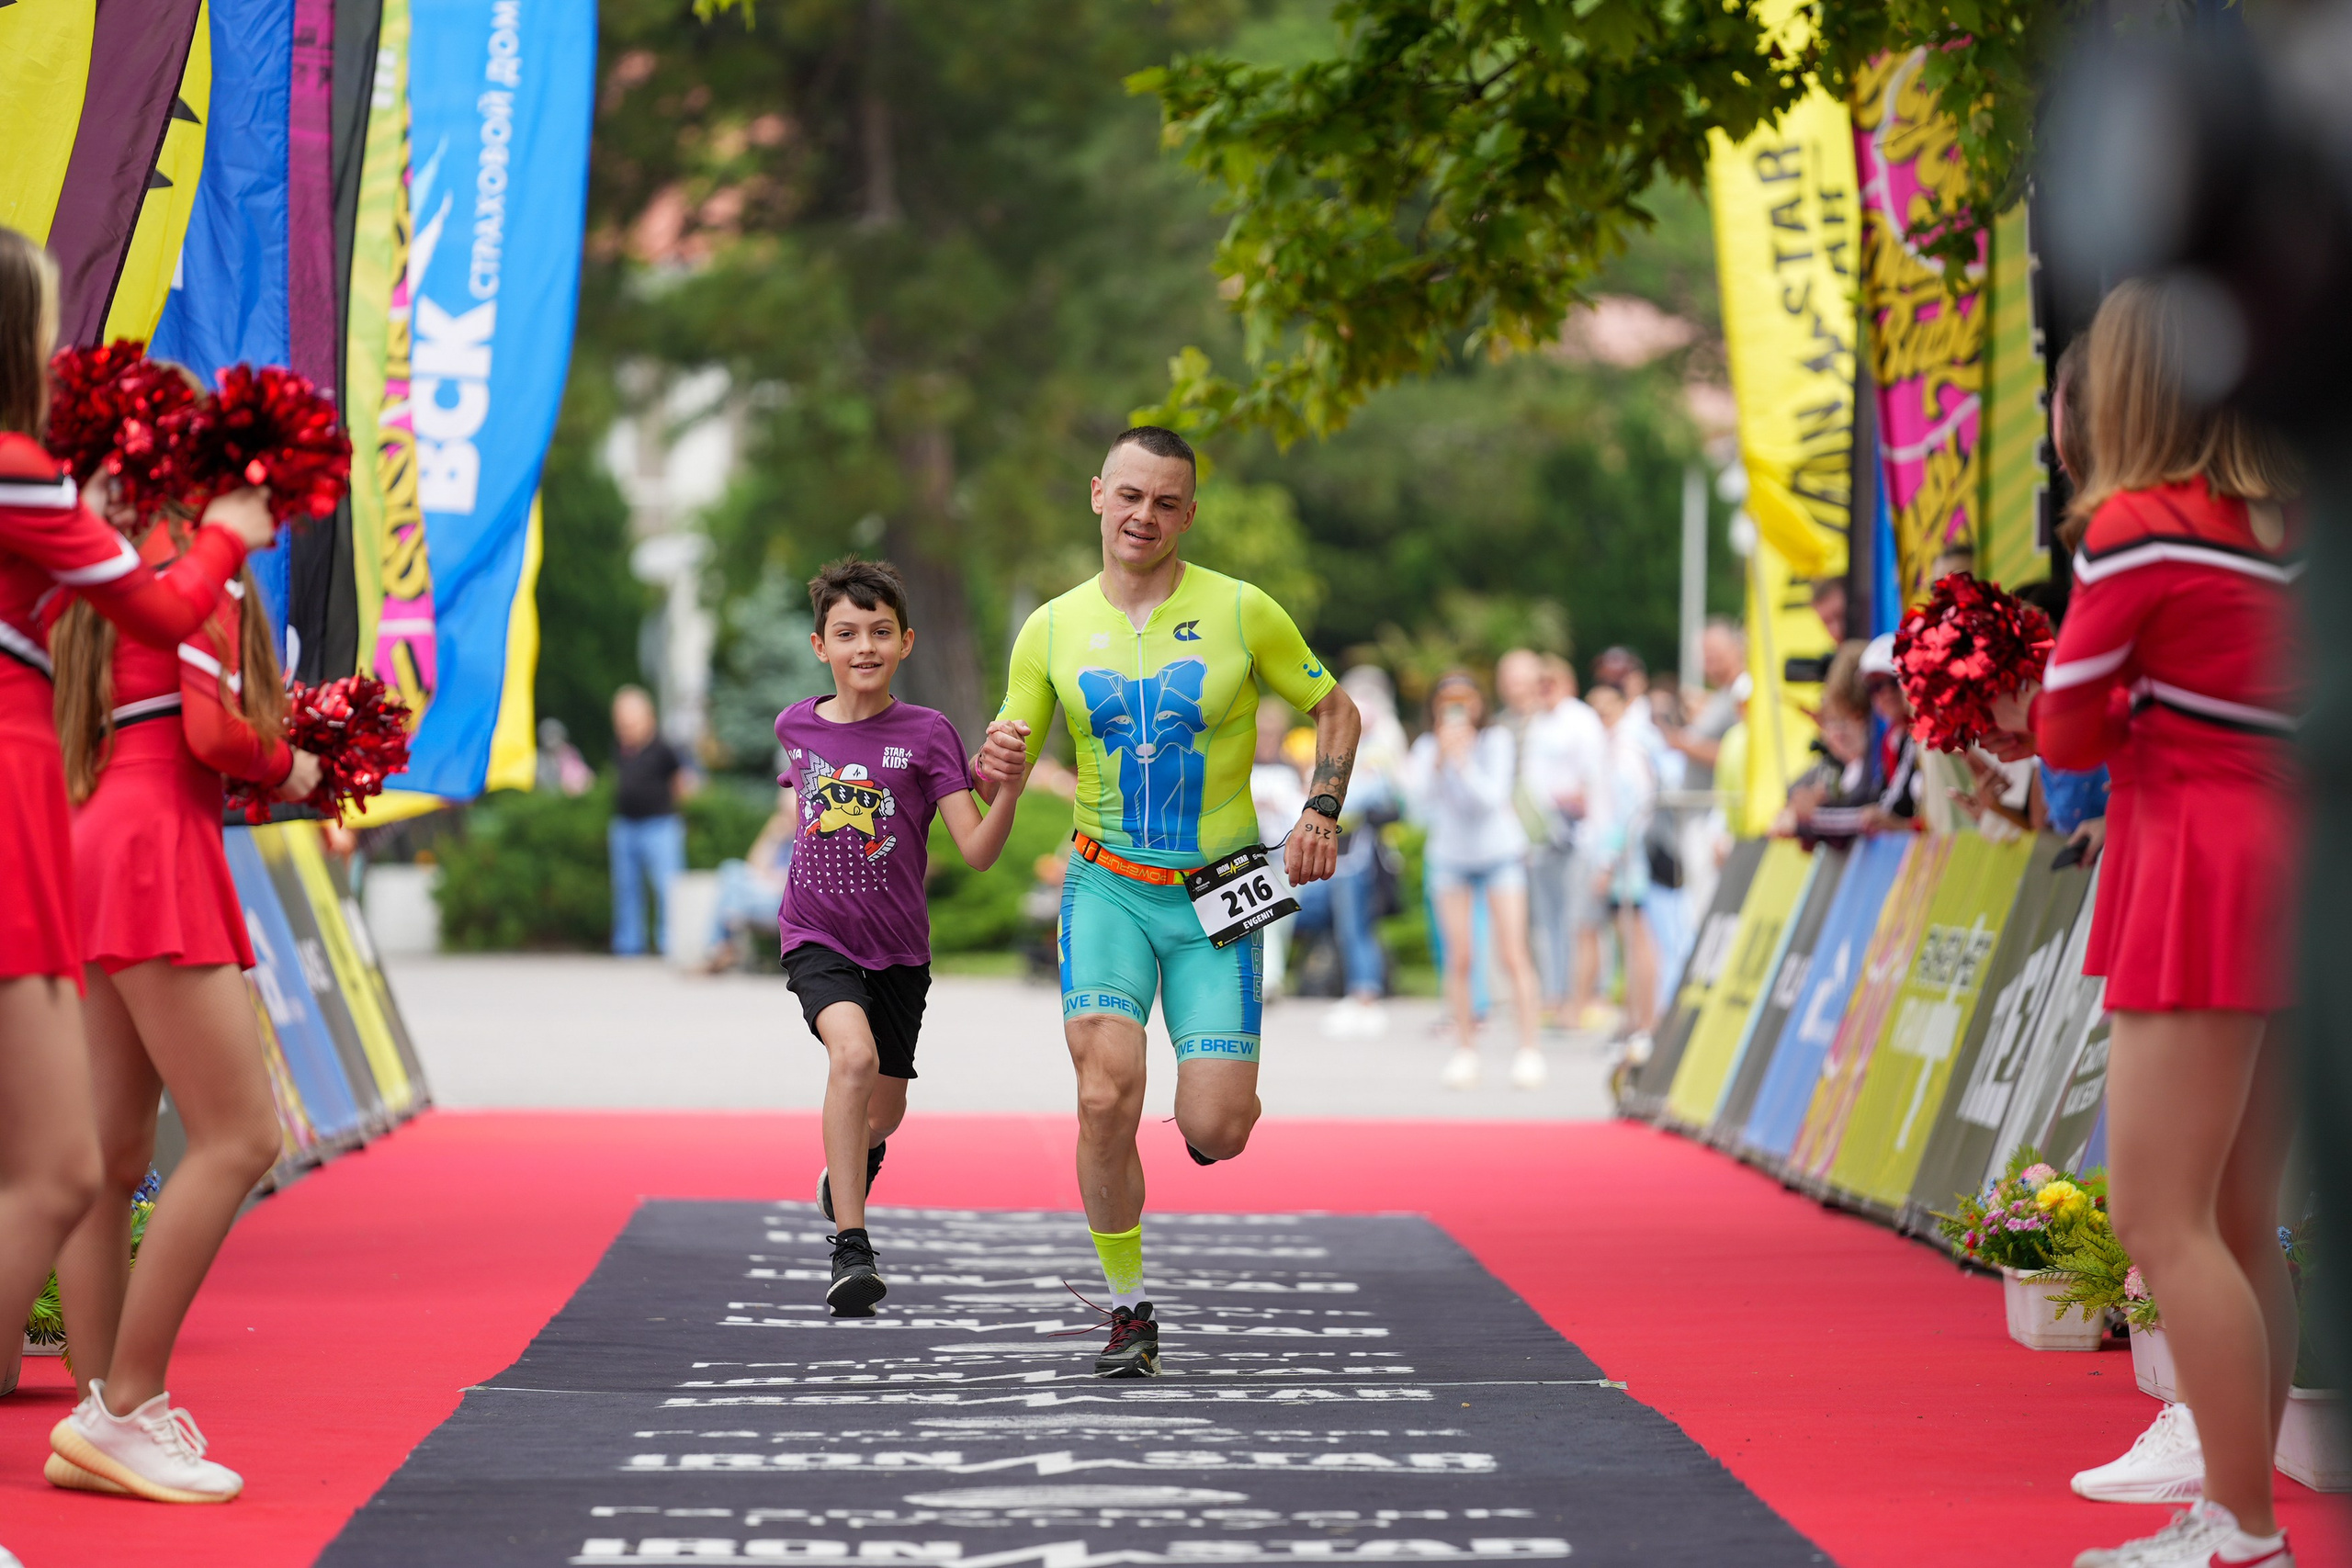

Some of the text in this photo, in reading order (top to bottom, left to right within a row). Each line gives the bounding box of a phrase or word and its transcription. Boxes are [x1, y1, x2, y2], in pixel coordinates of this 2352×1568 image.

[469, 90, 514, 300] СТРАХОВОЙ
[1755, 142, 1815, 316] STAR
[413, 293, 497, 515] ВСК
[884, 746, 905, 757] STAR
[882, 757, 909, 770] KIDS
[1216, 863, 1230, 875] IRON
[1233, 854, 1249, 866] STAR
[1220, 874, 1272, 918] 216
[1242, 908, 1274, 930] EVGENIY
[1099, 994, 1140, 1019] BREW
[1201, 1039, 1254, 1055] BREW
[664, 1388, 1434, 1404] IRON STAR
[631, 1450, 1497, 1469] IRON STAR
[582, 1537, 1571, 1559] IRON STAR
